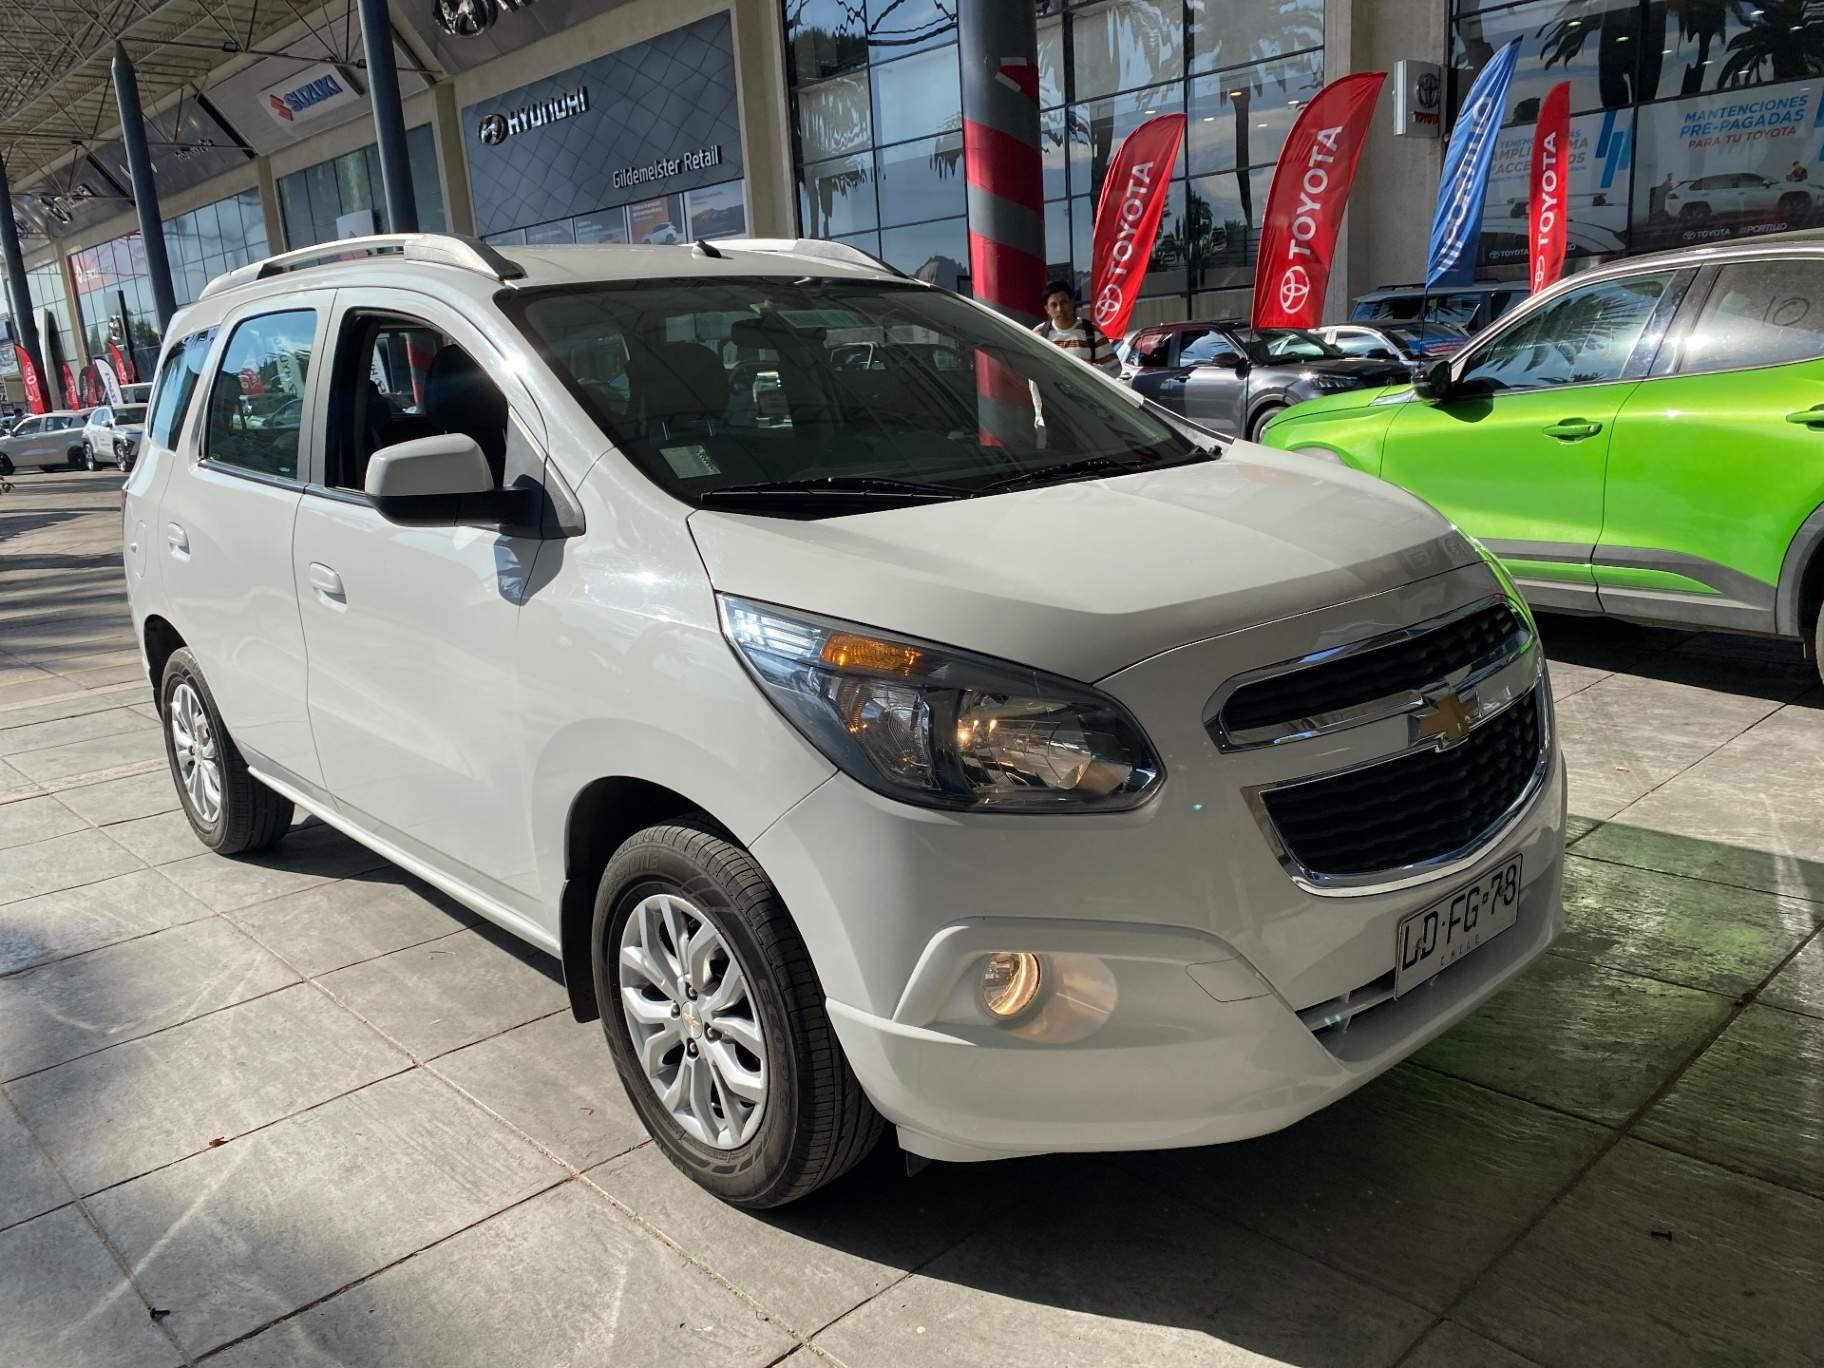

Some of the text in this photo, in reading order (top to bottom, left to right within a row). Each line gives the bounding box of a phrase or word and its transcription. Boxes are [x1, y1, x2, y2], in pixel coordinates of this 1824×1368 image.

[284, 74, 343, 113] SUZUKI
[508, 87, 590, 136] HYUNDAI
[1684, 95, 1808, 124] MANTENCIONES
[1680, 109, 1806, 139] PRE-PAGADAS
[1688, 126, 1797, 150] PARA TU TOYOTA
[612, 144, 721, 189] Gildemeister Retail
[1287, 125, 1343, 259] TOYOTA
[1538, 131, 1558, 251] TOYOTA
[1107, 160, 1154, 277] TOYOTA
[1697, 228, 1731, 239] TOYOTA
